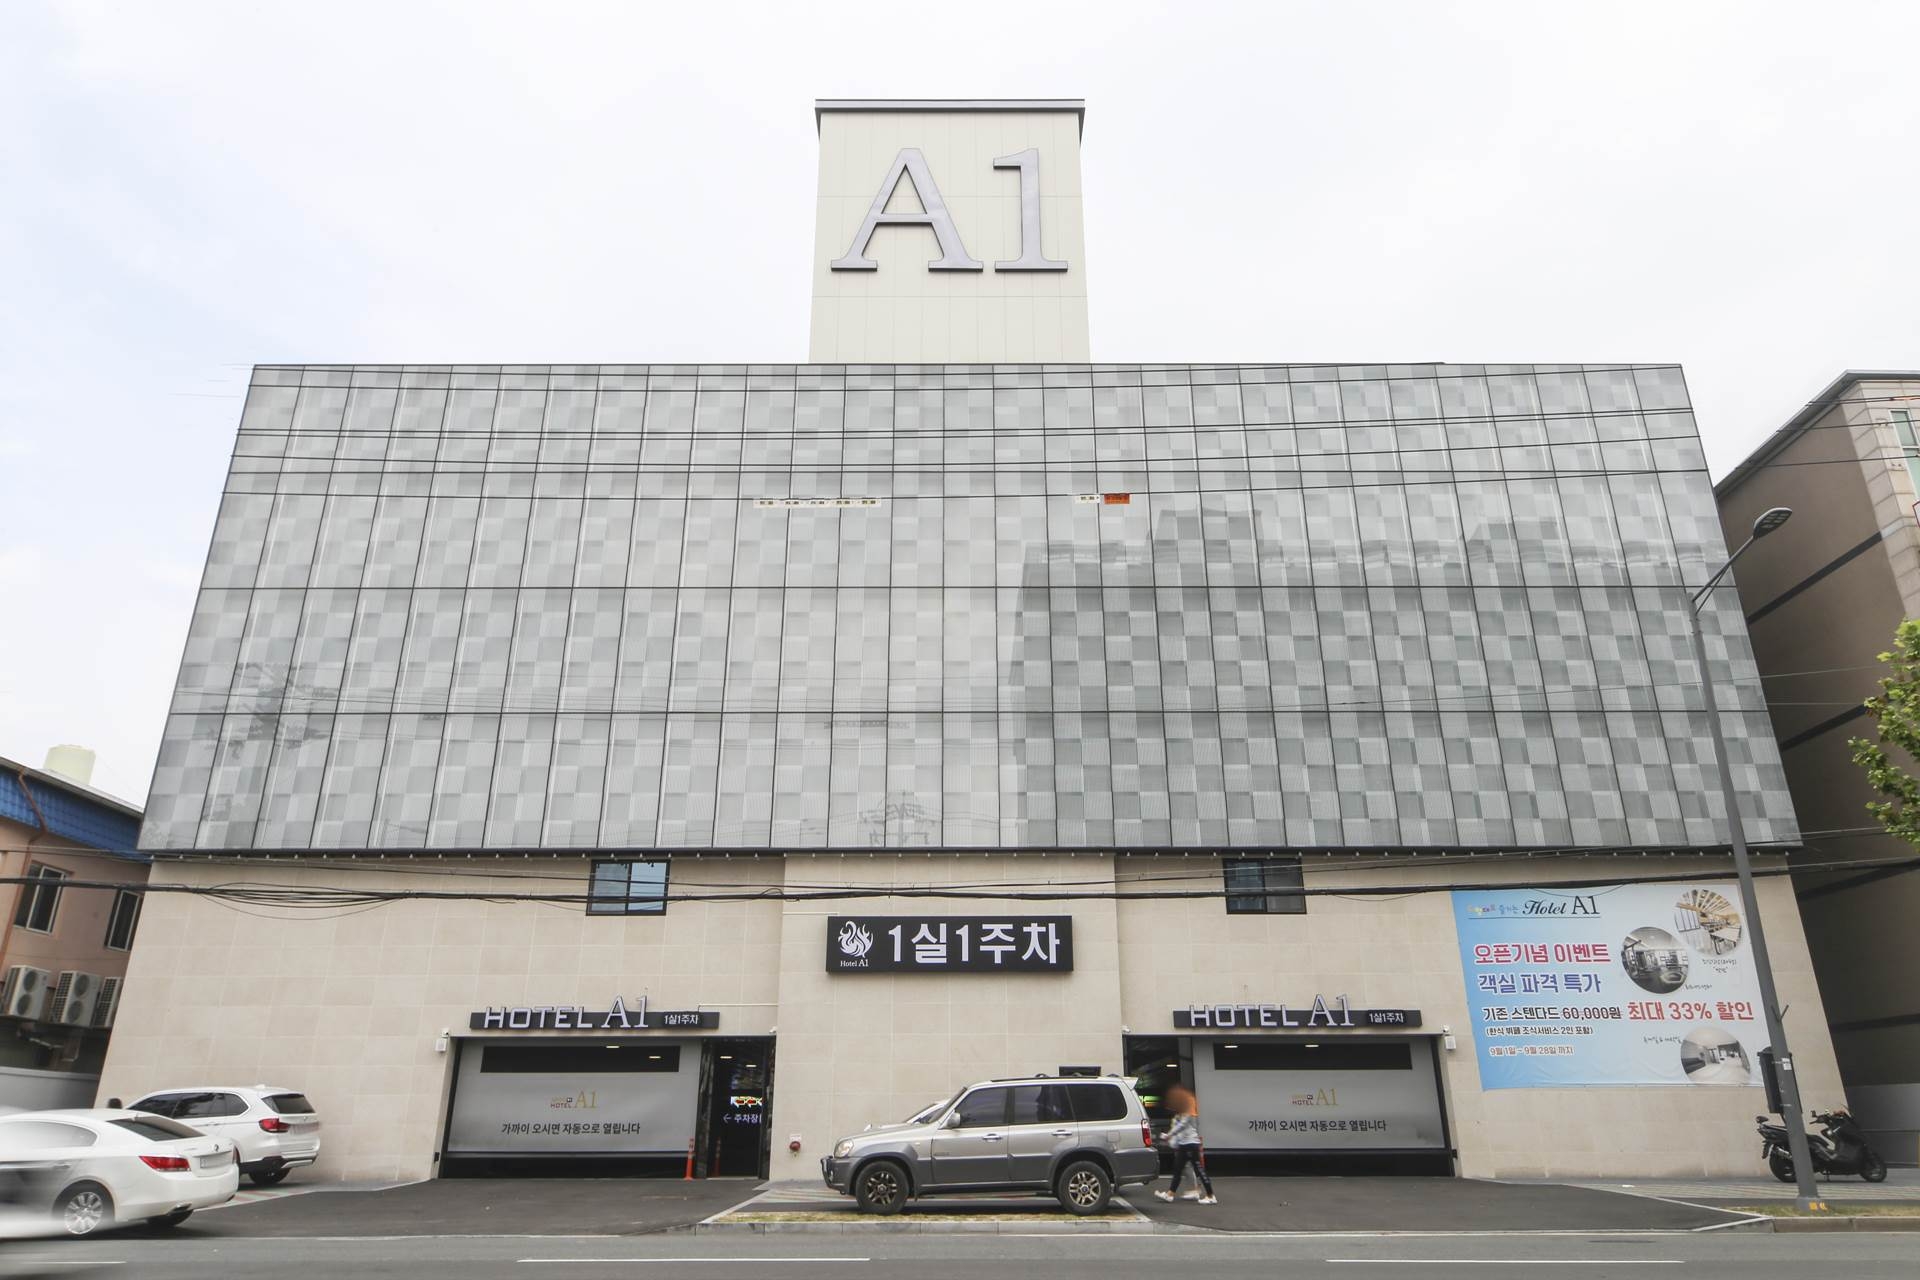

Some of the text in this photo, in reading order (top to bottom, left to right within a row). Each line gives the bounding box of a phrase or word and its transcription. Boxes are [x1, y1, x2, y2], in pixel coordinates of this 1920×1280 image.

[831, 148, 1068, 272] A1
[1522, 899, 1567, 914] Hotel
[1571, 896, 1600, 915] A1
[888, 923, 1061, 964] 1실1주차
[1475, 943, 1611, 963] 오픈기념 이벤트
[1479, 974, 1601, 994] 객실 파격 특가
[484, 995, 648, 1029] HOTEL A1
[665, 1014, 698, 1025] 1실1주차
[1189, 993, 1355, 1027] HOTEL A1
[1369, 1012, 1404, 1024] 1실1주차
[1483, 1006, 1622, 1021] 기존 스텐다드 60,000원
[1628, 1001, 1755, 1021] 최대 33% 할인
[1561, 1027, 1574, 1035] 2인
[574, 1090, 599, 1109] A1
[1315, 1088, 1339, 1106] A1
[501, 1122, 641, 1135] 가까이 오시면 자동으로 열립니다
[1248, 1120, 1386, 1132] 가까이 오시면 자동으로 열립니다
